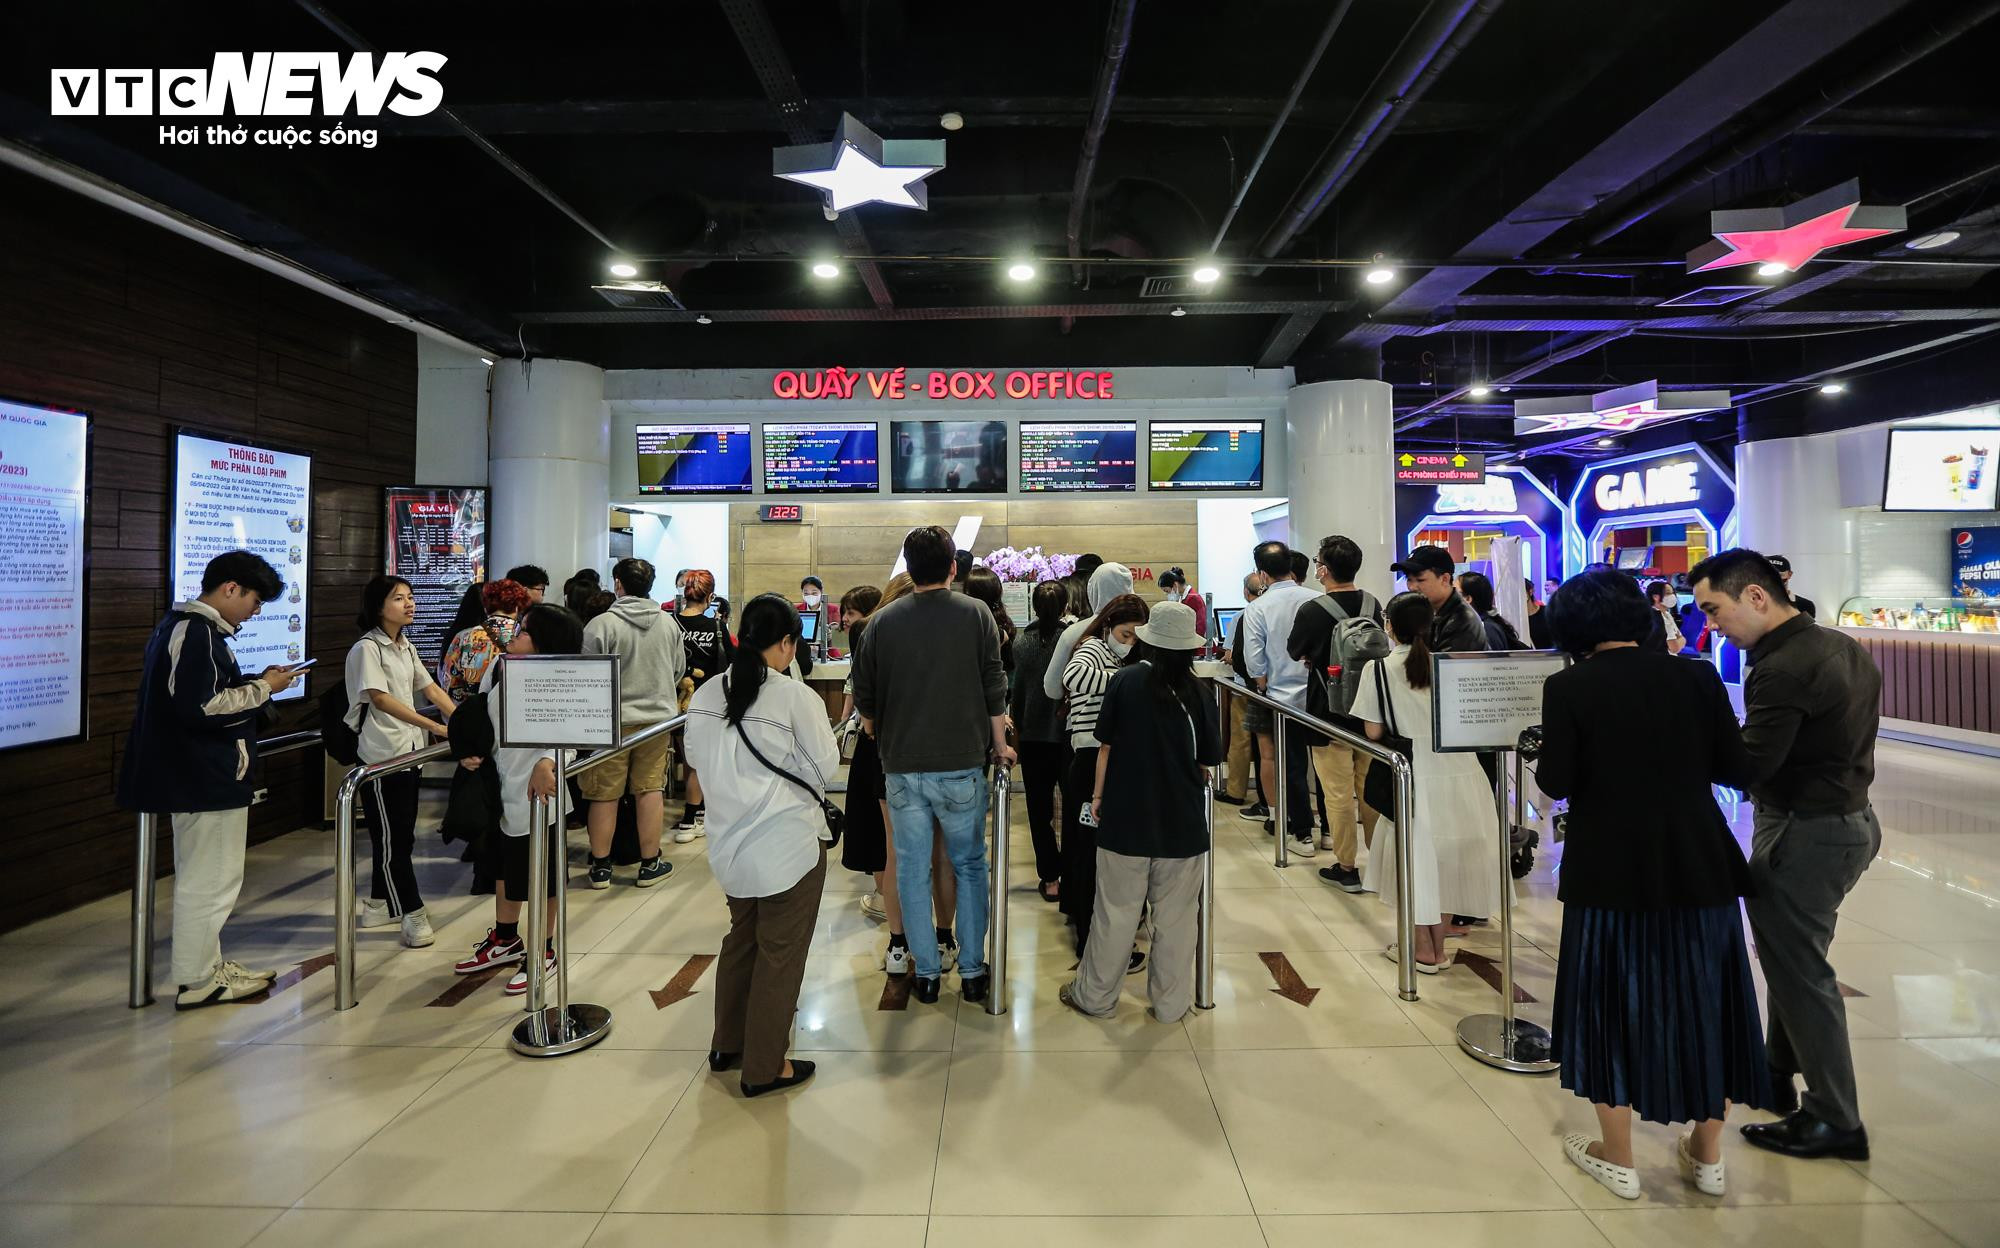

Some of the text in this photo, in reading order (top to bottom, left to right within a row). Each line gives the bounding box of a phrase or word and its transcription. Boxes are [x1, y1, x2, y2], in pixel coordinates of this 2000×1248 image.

[773, 366, 860, 399] QUẦY
[866, 367, 905, 399] VÉ
[928, 371, 996, 399] BOX
[1005, 371, 1113, 399] OFFICE
[33, 418, 47, 427] GIA
[228, 447, 275, 465] THÔNG BÁO
[1416, 456, 1449, 465] CINEMA
[252, 465, 268, 478] LOẠI
[269, 468, 287, 479] PHIM
[1398, 470, 1412, 479] CÁC
[1413, 470, 1438, 479] PHÒNG
[1439, 469, 1459, 479] CHIẾU
[1594, 461, 1701, 511] GAME
[1130, 567, 1154, 581] GIA
[1960, 571, 1982, 581] PEPSI
